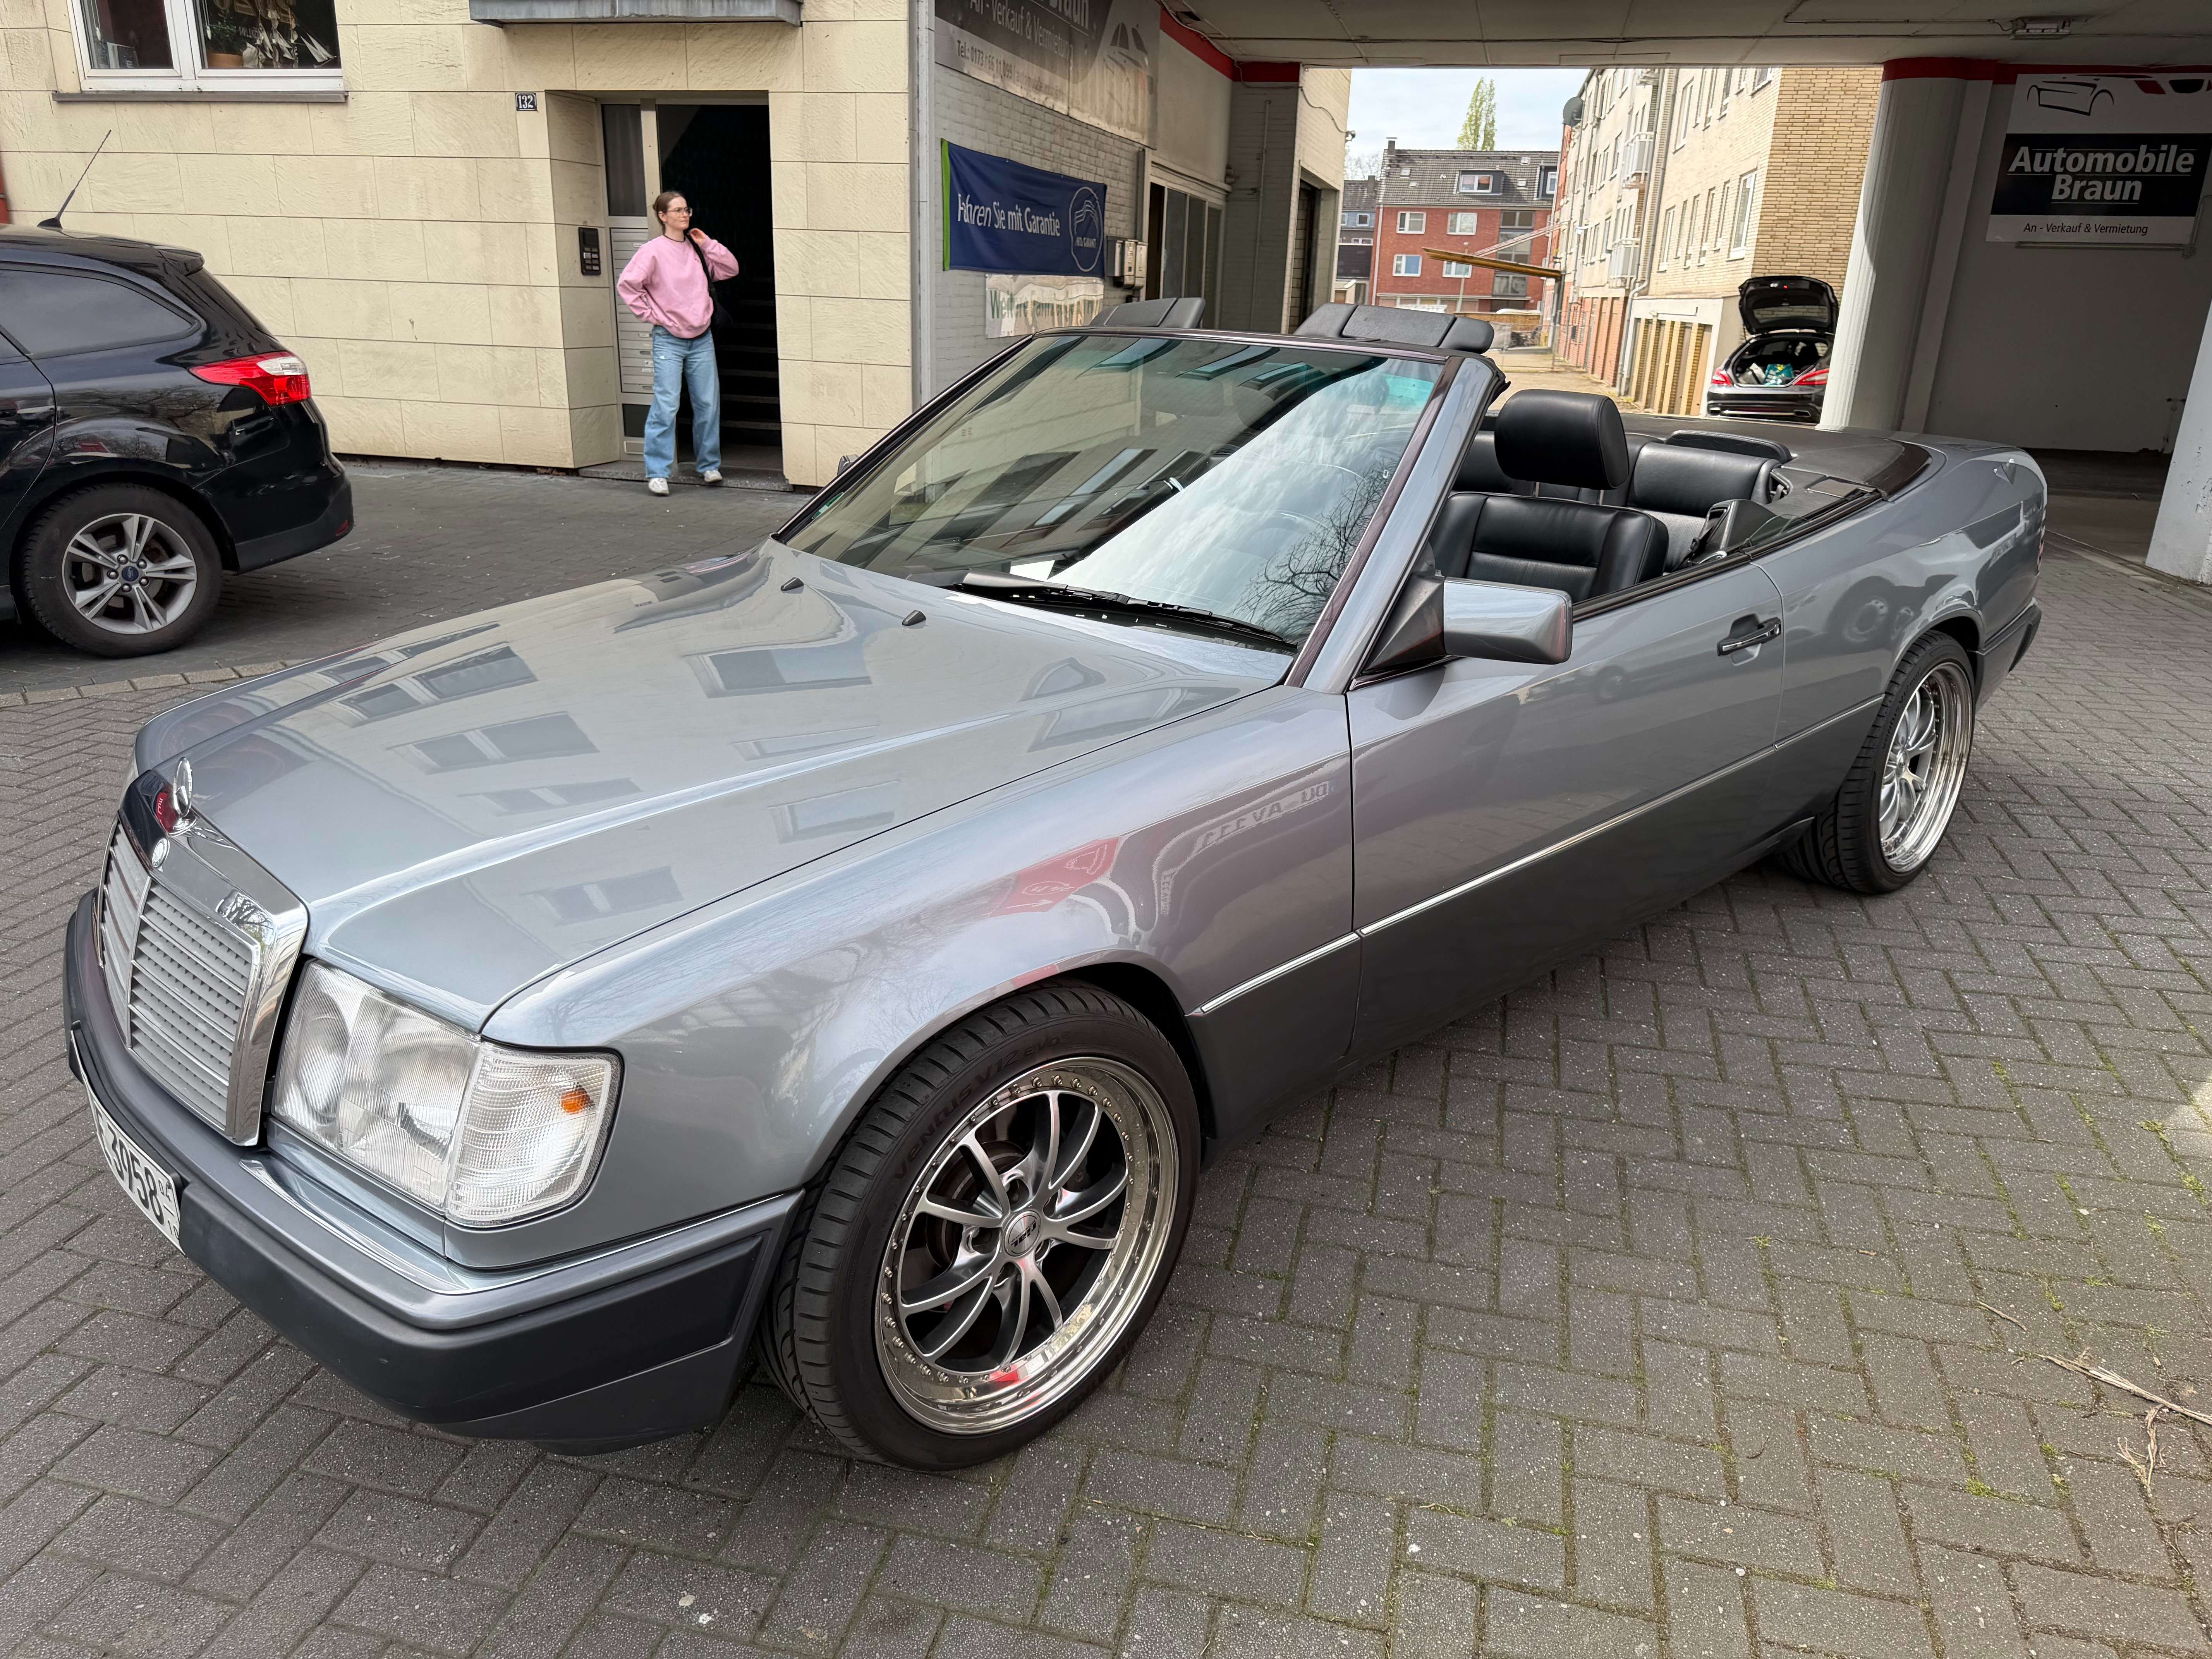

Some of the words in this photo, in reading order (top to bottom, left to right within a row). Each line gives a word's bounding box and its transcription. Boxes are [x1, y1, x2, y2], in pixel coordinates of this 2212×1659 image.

[992, 0, 1024, 36] Verkauf
[1026, 11, 1032, 40] &
[518, 95, 534, 108] 132
[2008, 144, 2195, 173] Automobile
[2051, 174, 2142, 201] Braun
[957, 193, 992, 227] Fahren
[993, 201, 1006, 229] Sie
[1008, 204, 1024, 232] mit
[1024, 207, 1061, 237] Garantie
[2023, 223, 2036, 232] An
[2046, 223, 2083, 233] Verkauf
[2084, 223, 2091, 233] &
[2094, 223, 2148, 236] Vermietung
